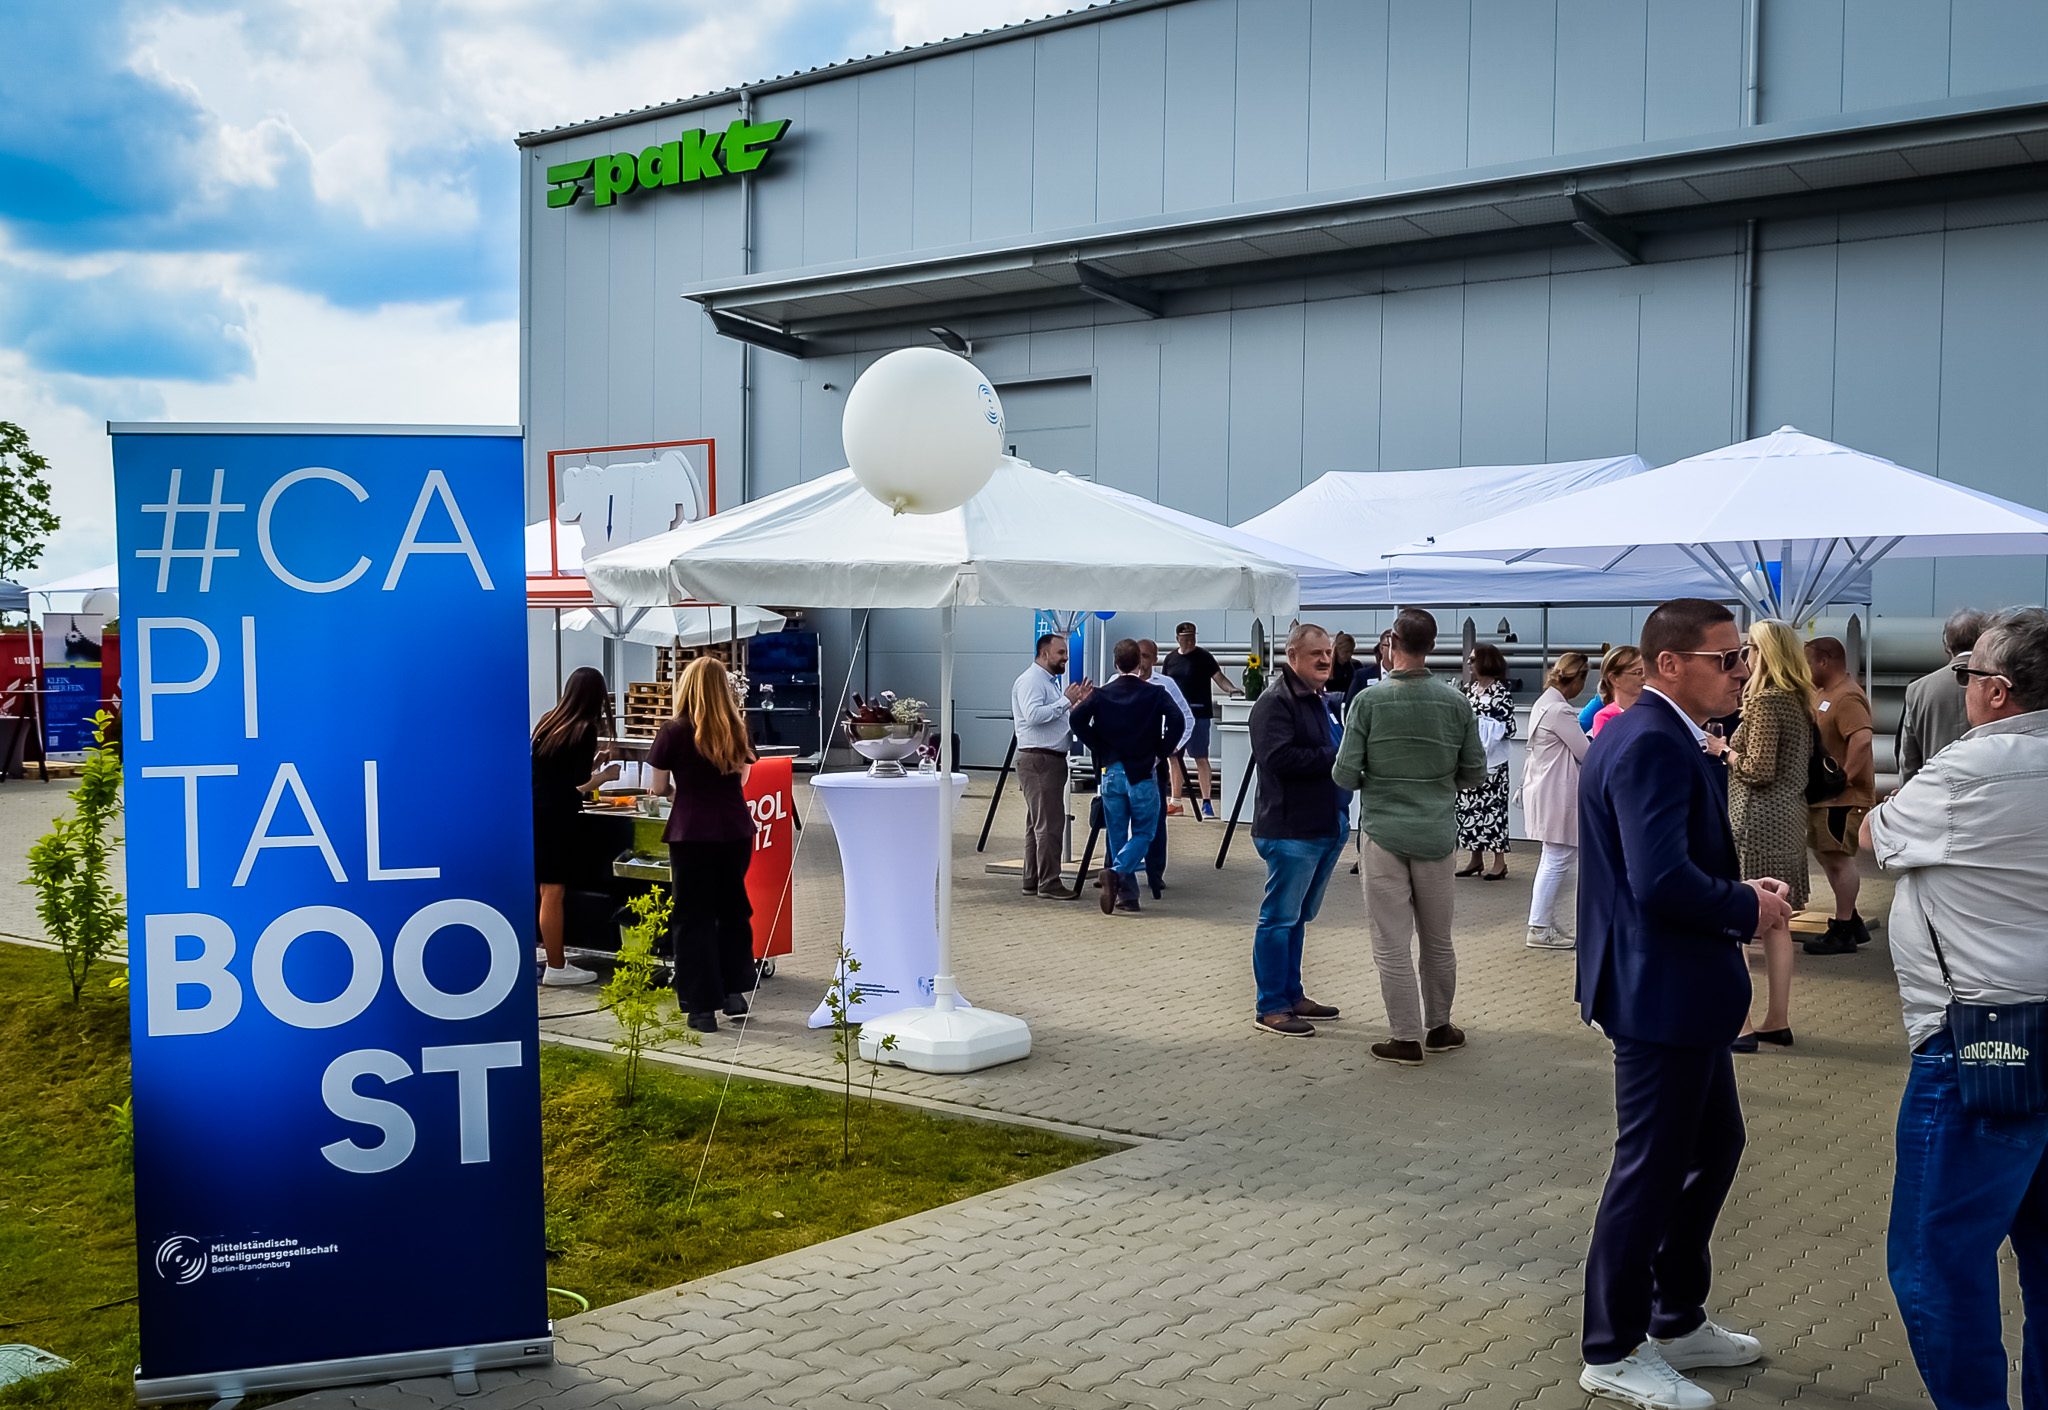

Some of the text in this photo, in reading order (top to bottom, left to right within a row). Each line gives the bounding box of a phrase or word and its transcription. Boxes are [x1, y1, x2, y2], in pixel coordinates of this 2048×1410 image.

[594, 119, 792, 207] pakt
[136, 467, 495, 593] #CA
[137, 616, 258, 741] PI
[141, 761, 441, 889] TAL
[145, 898, 521, 1037] BOO
[1959, 1040, 2030, 1060] LONGCHAMP
[320, 1041, 522, 1174] ST
[211, 1238, 298, 1253] Mittelständische
[211, 1244, 339, 1263] Beteiligungsgesellschaft
[211, 1261, 291, 1274] Berlin-Brandenburg
